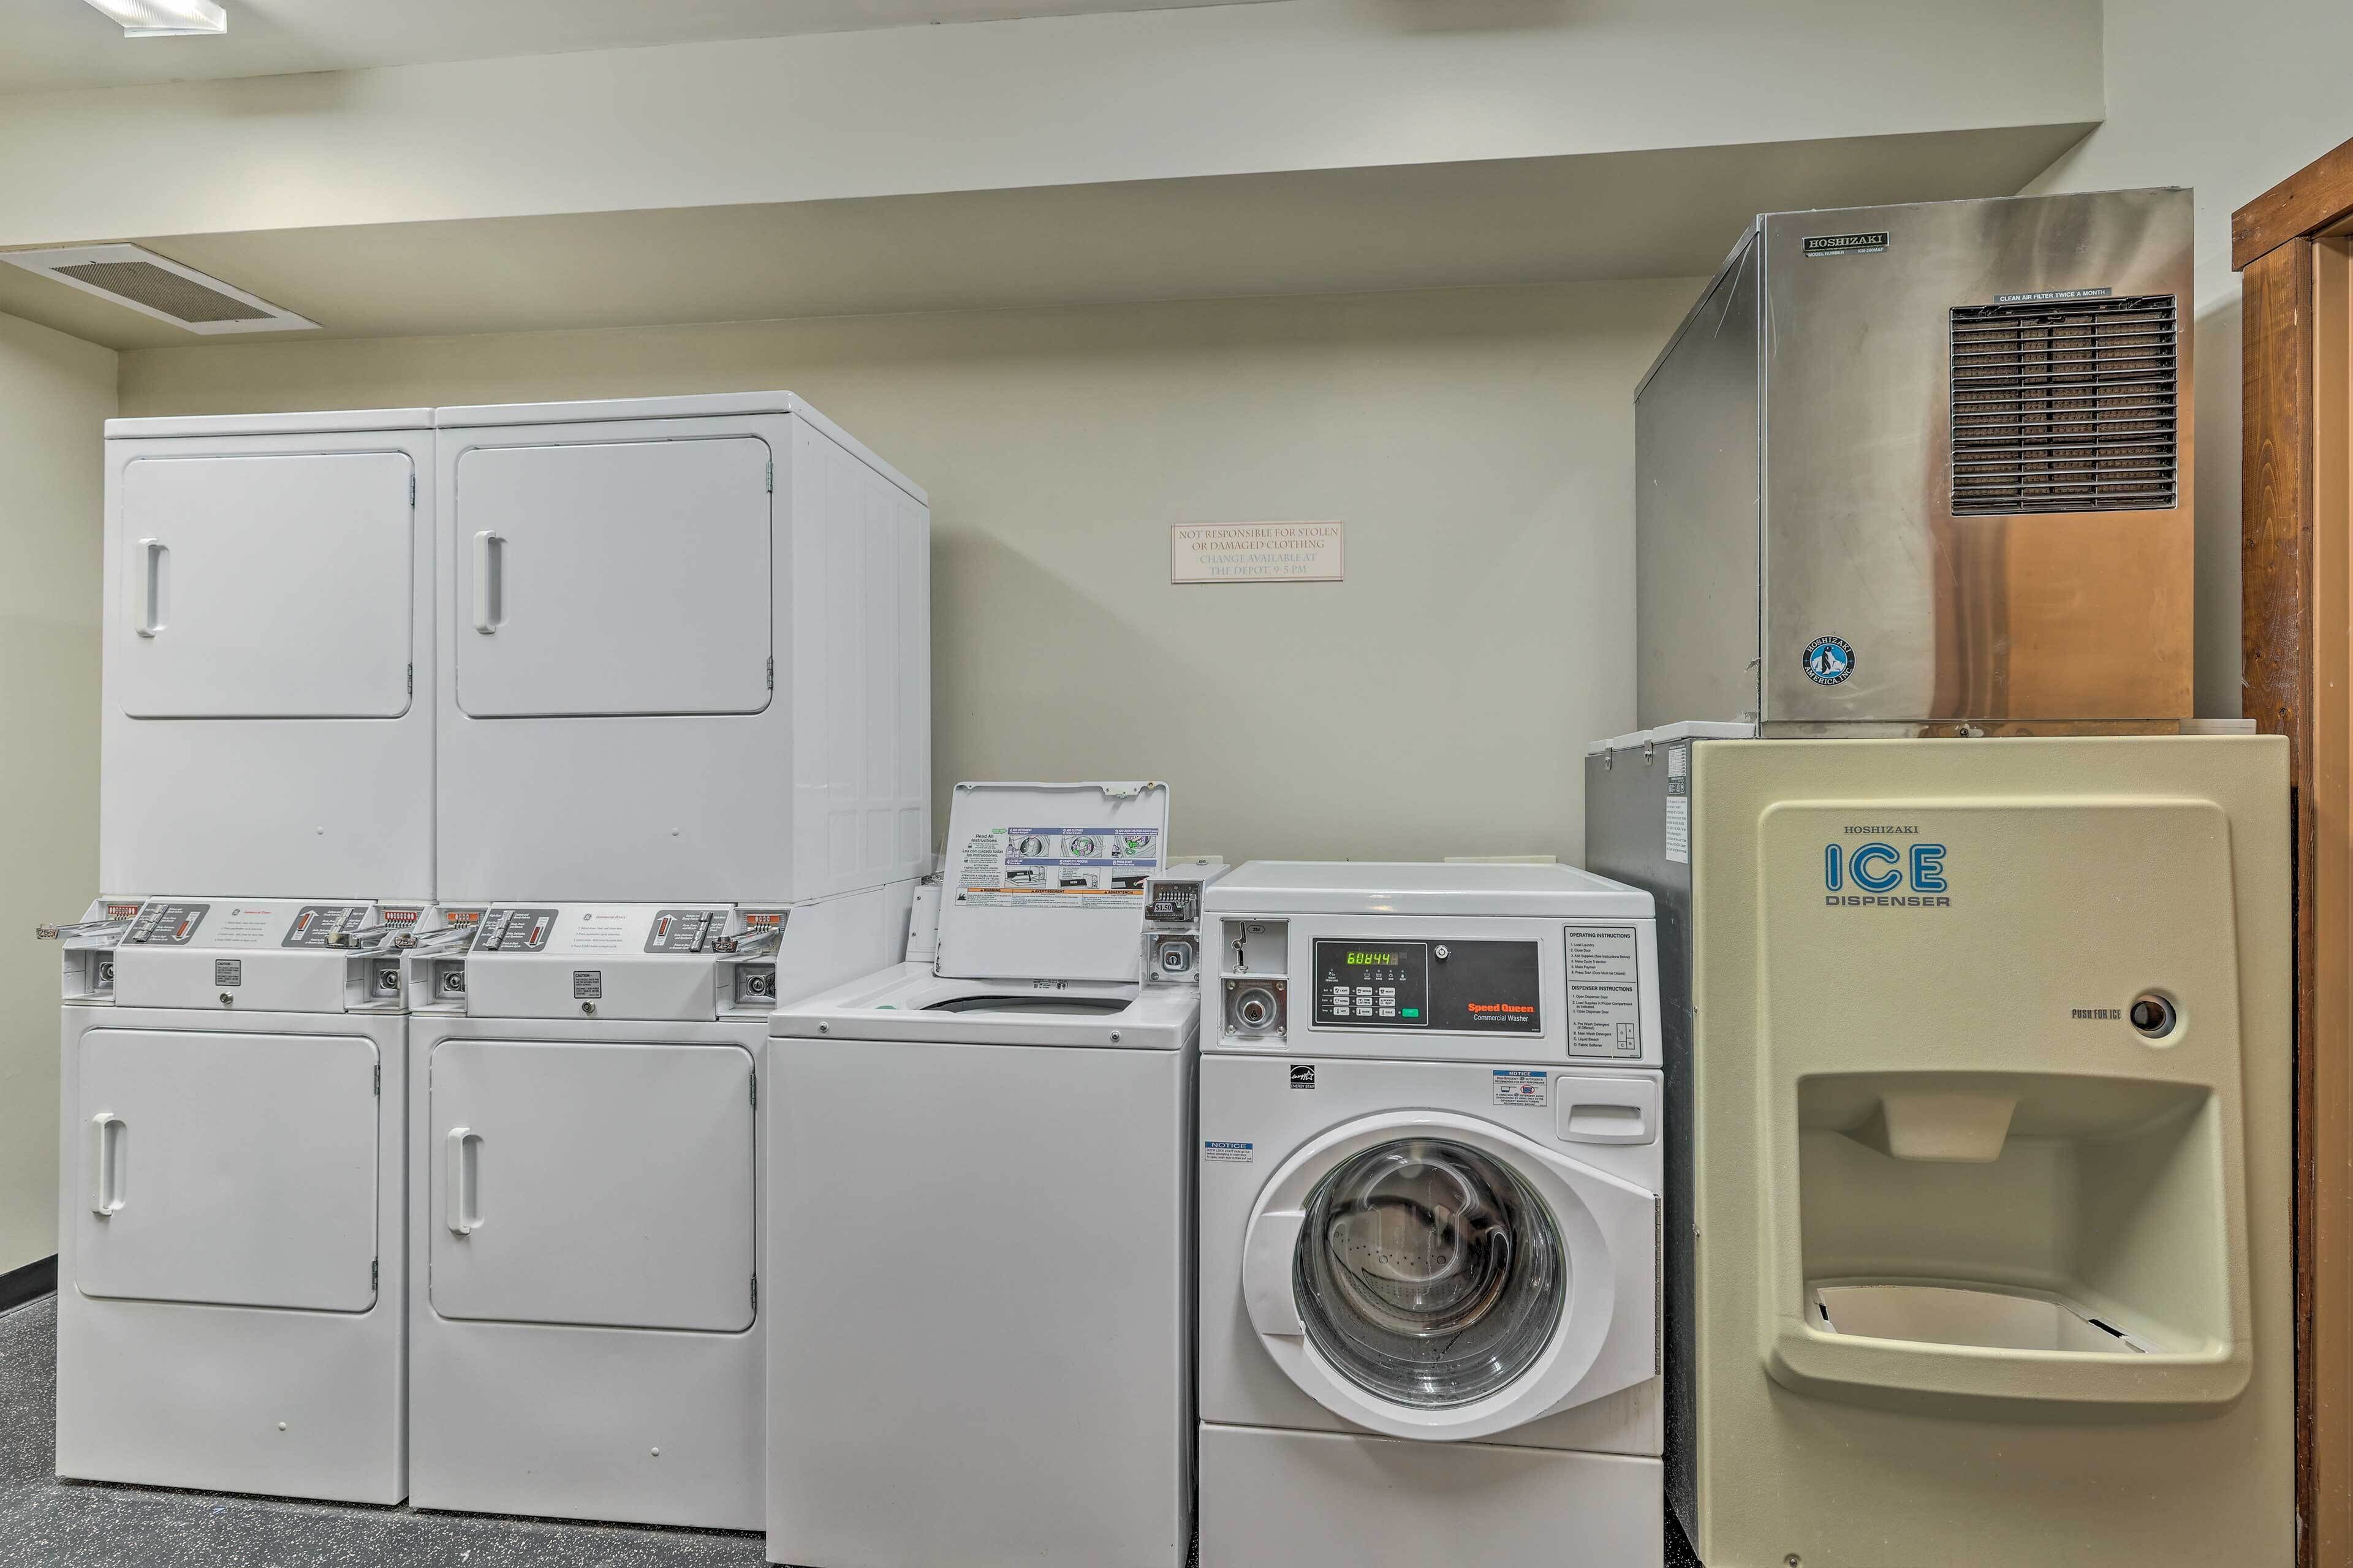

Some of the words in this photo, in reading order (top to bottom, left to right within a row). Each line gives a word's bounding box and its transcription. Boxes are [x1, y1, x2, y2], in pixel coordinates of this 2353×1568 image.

[1809, 235, 1883, 248] HOSHIZAKI
[1178, 529, 1202, 539] NOT
[1205, 529, 1272, 539] RESPONSIBLE
[1275, 528, 1296, 537] FOR
[1298, 527, 1338, 537] STOLEN
[1192, 542, 1207, 551] OR
[1210, 540, 1264, 550] DAMAGED
[1266, 539, 1325, 550] CLOTHING
[1200, 555, 1245, 564] CHANGE
[1245, 553, 1301, 563] AVAILABLE
[1303, 553, 1317, 562] AT
[1209, 566, 1230, 575] THE
[1292, 564, 1307, 574] PM
[1806, 637, 1852, 653] HOSHIZAKI
[1825, 842, 1948, 893] ICE
[1826, 896, 1950, 907] DISPENSER
[1468, 1002, 1500, 1013] Speed
[1501, 1004, 1534, 1012] Queen
[2072, 1009, 2092, 1019] PUSH
[2094, 1009, 2107, 1019] FOR
[2110, 1009, 2121, 1020] ICE
